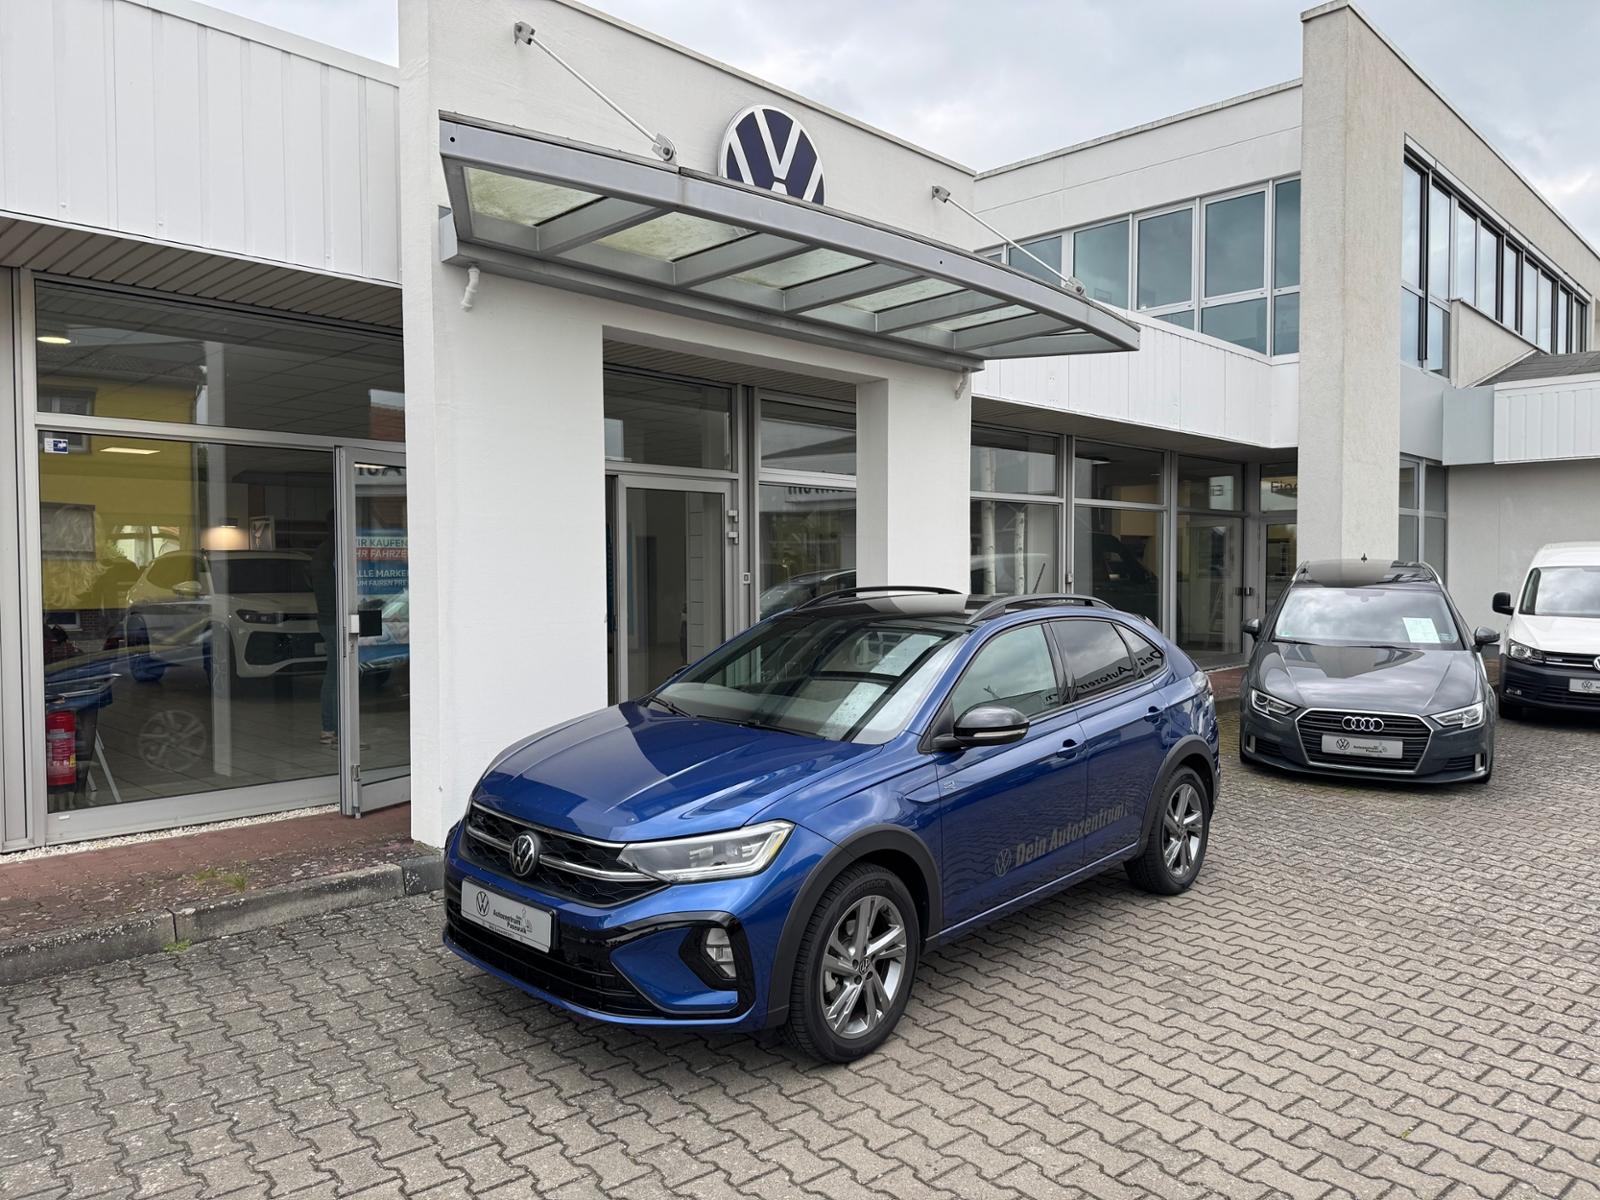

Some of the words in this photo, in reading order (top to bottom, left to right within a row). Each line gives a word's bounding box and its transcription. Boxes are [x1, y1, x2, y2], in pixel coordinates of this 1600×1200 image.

[356, 539, 367, 547] IR
[353, 549, 368, 558] HR
[370, 549, 407, 558] FAHRZE
[357, 569, 374, 578] LLE
[376, 569, 408, 578] MARKE
[1015, 836, 1047, 867] Dein
